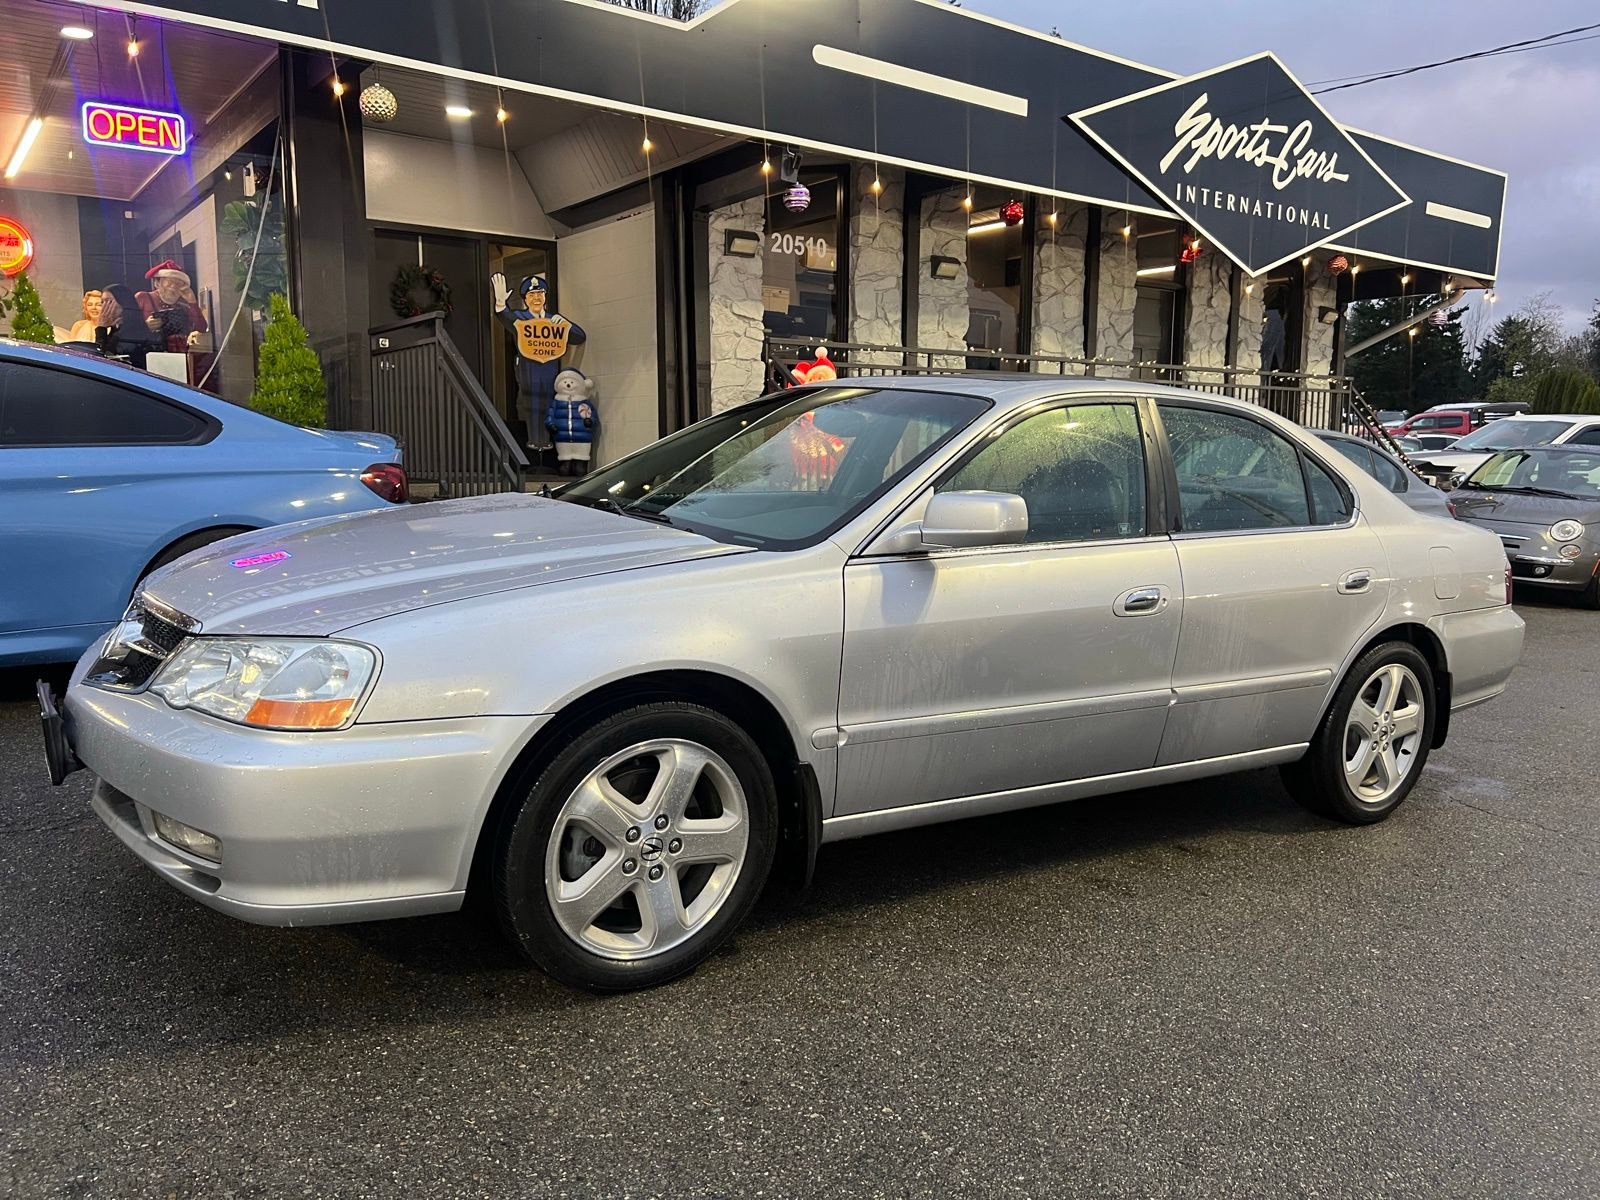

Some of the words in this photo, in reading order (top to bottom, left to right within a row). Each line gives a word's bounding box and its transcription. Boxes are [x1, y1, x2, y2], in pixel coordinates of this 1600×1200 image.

[88, 109, 180, 148] OPEN
[1160, 93, 1288, 174] Sports
[1272, 120, 1349, 190] Cars
[1176, 183, 1331, 230] INTERNATIONAL
[771, 232, 826, 258] 20510
[524, 325, 565, 340] SLOW
[527, 340, 561, 348] SCHOOL
